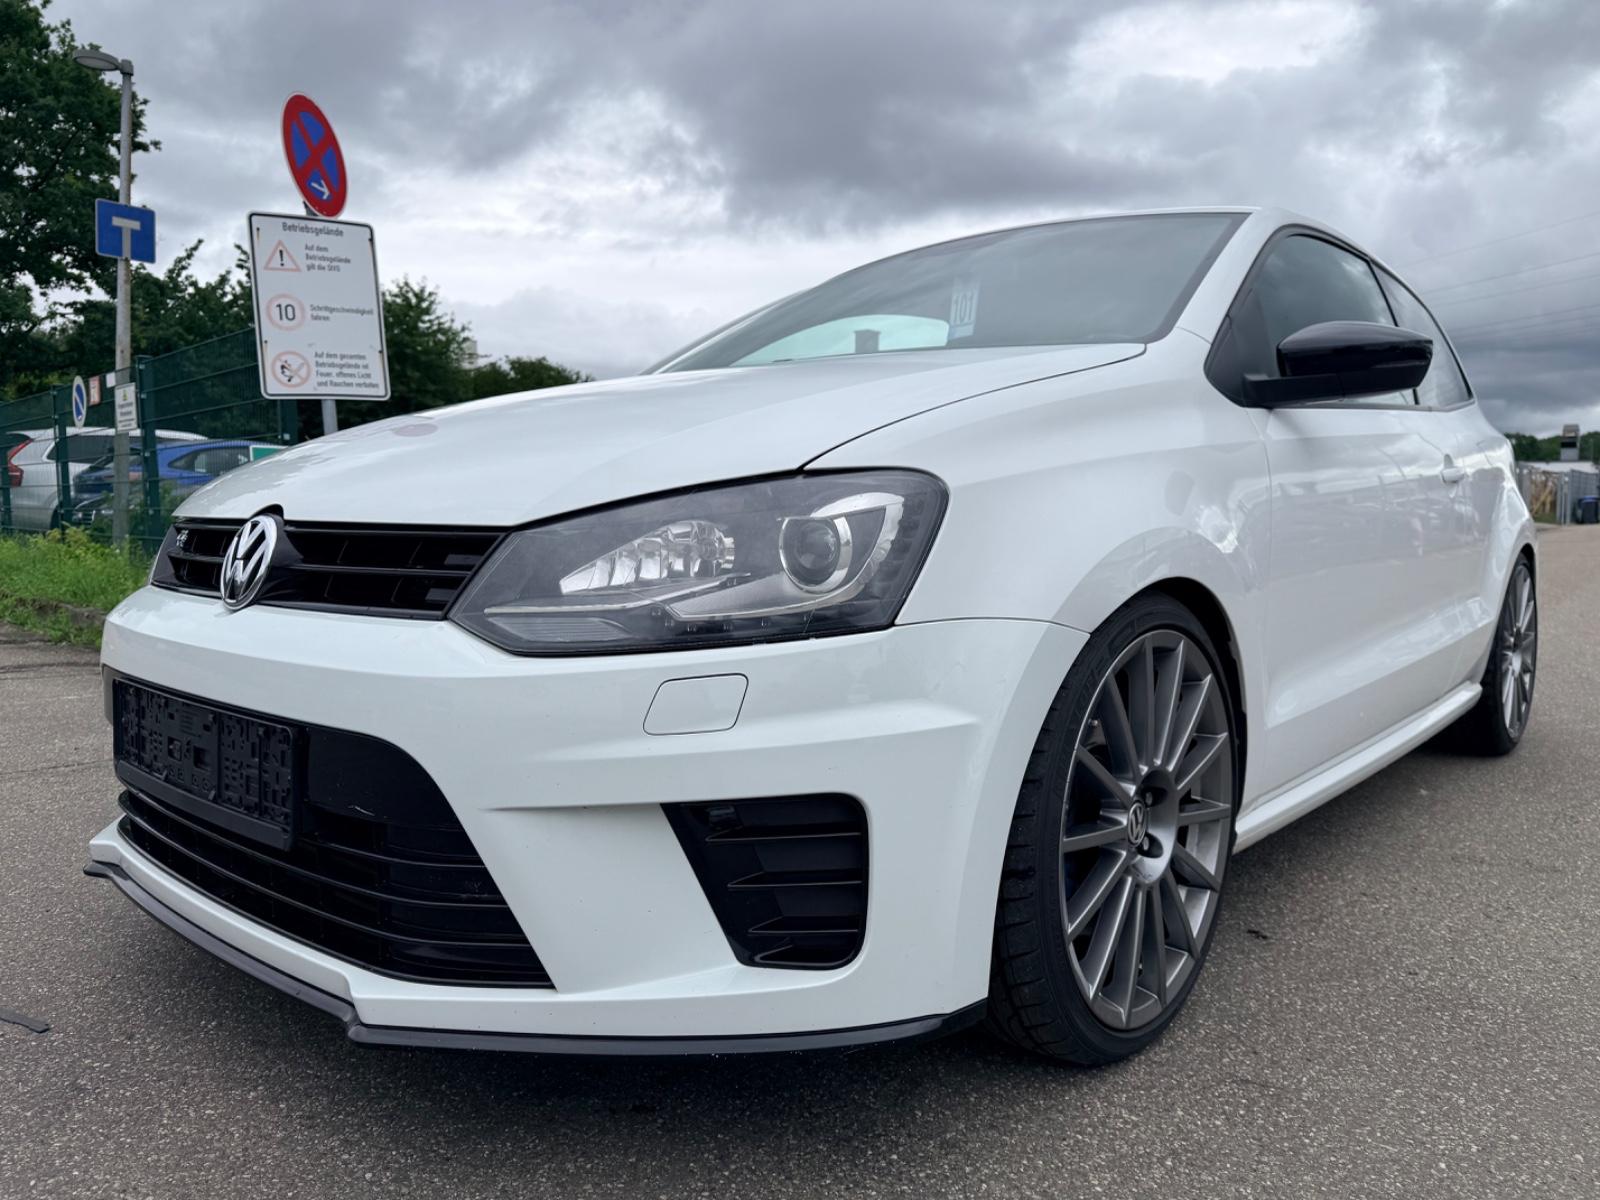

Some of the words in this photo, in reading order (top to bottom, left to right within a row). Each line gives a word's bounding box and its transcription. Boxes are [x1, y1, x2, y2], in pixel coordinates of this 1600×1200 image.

[282, 222, 344, 237] Betriebsgelände
[276, 303, 296, 321] 10
[310, 304, 374, 316] Schrittgeschwindigkeit
